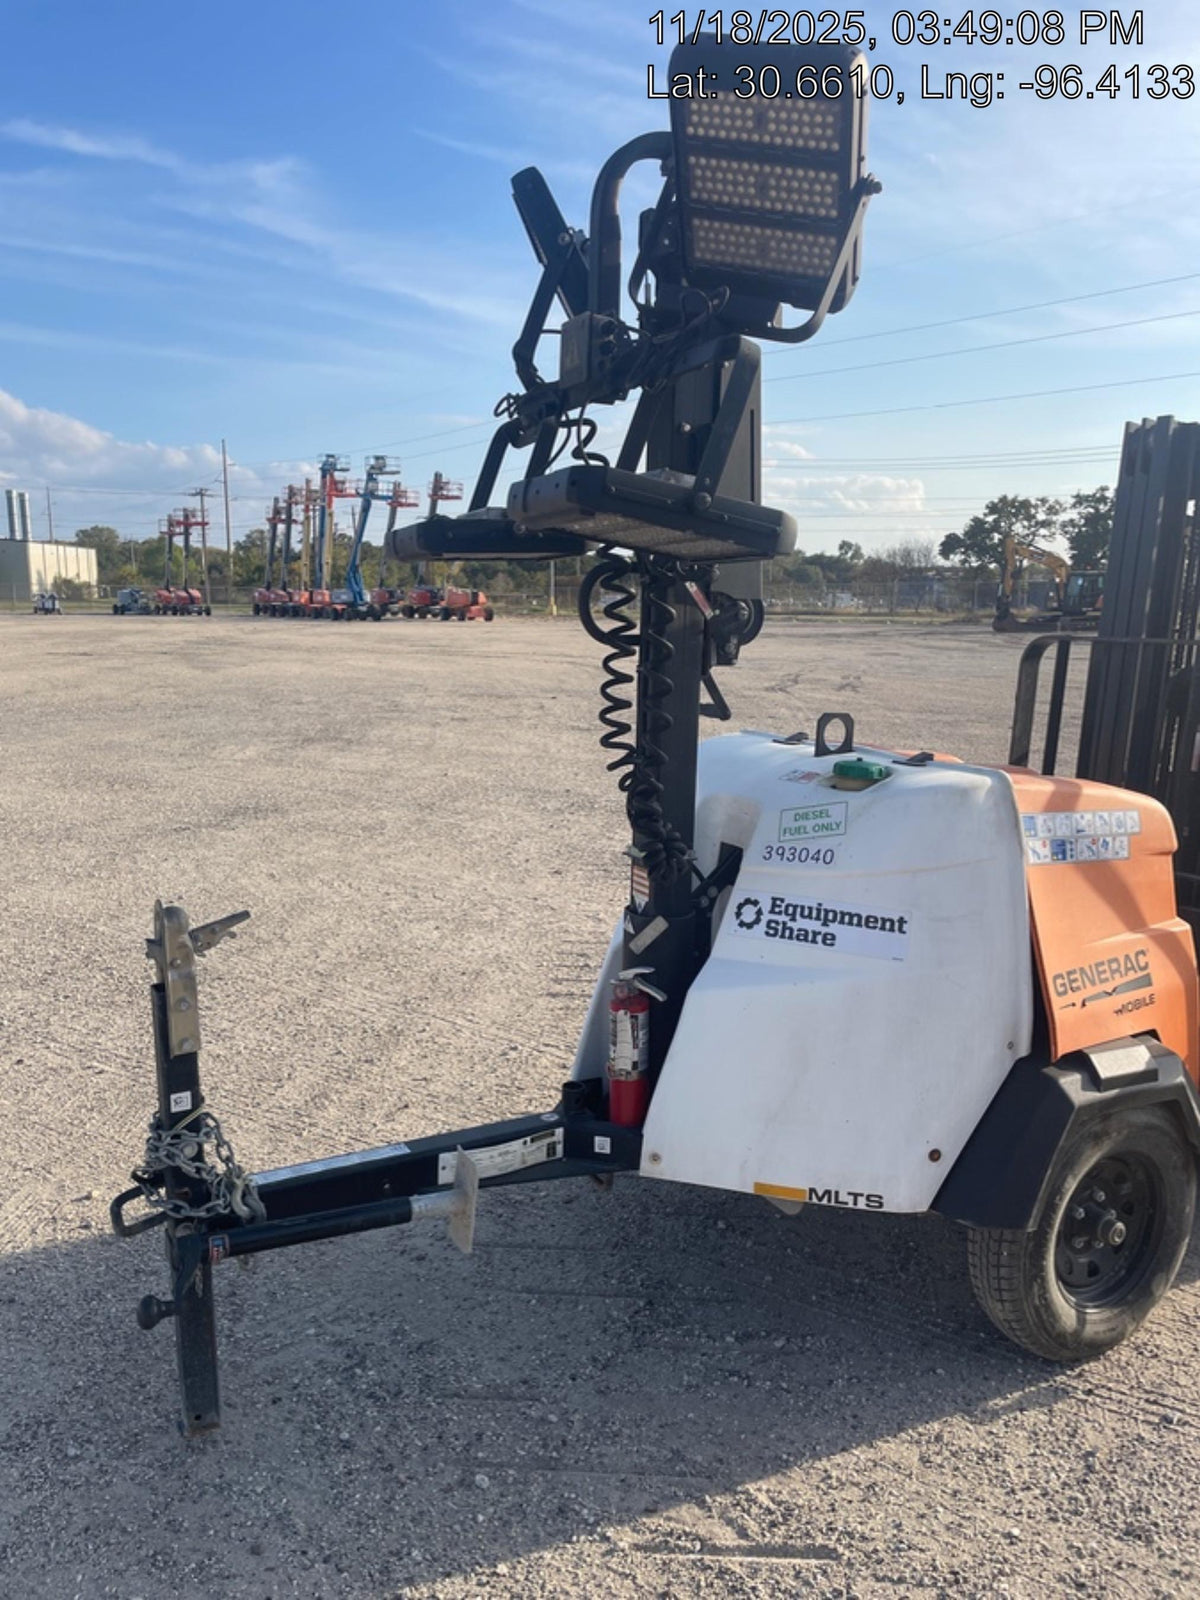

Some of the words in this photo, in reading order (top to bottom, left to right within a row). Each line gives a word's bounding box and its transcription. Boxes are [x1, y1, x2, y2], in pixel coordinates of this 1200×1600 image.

[794, 809, 831, 822] DIESEL
[783, 824, 809, 837] FUEL
[812, 821, 842, 833] ONLY
[763, 845, 834, 865] 393040
[767, 896, 908, 935] Equipment
[764, 918, 837, 947] Share
[1052, 948, 1150, 998] GENERAC
[808, 1187, 884, 1209] MLTS
